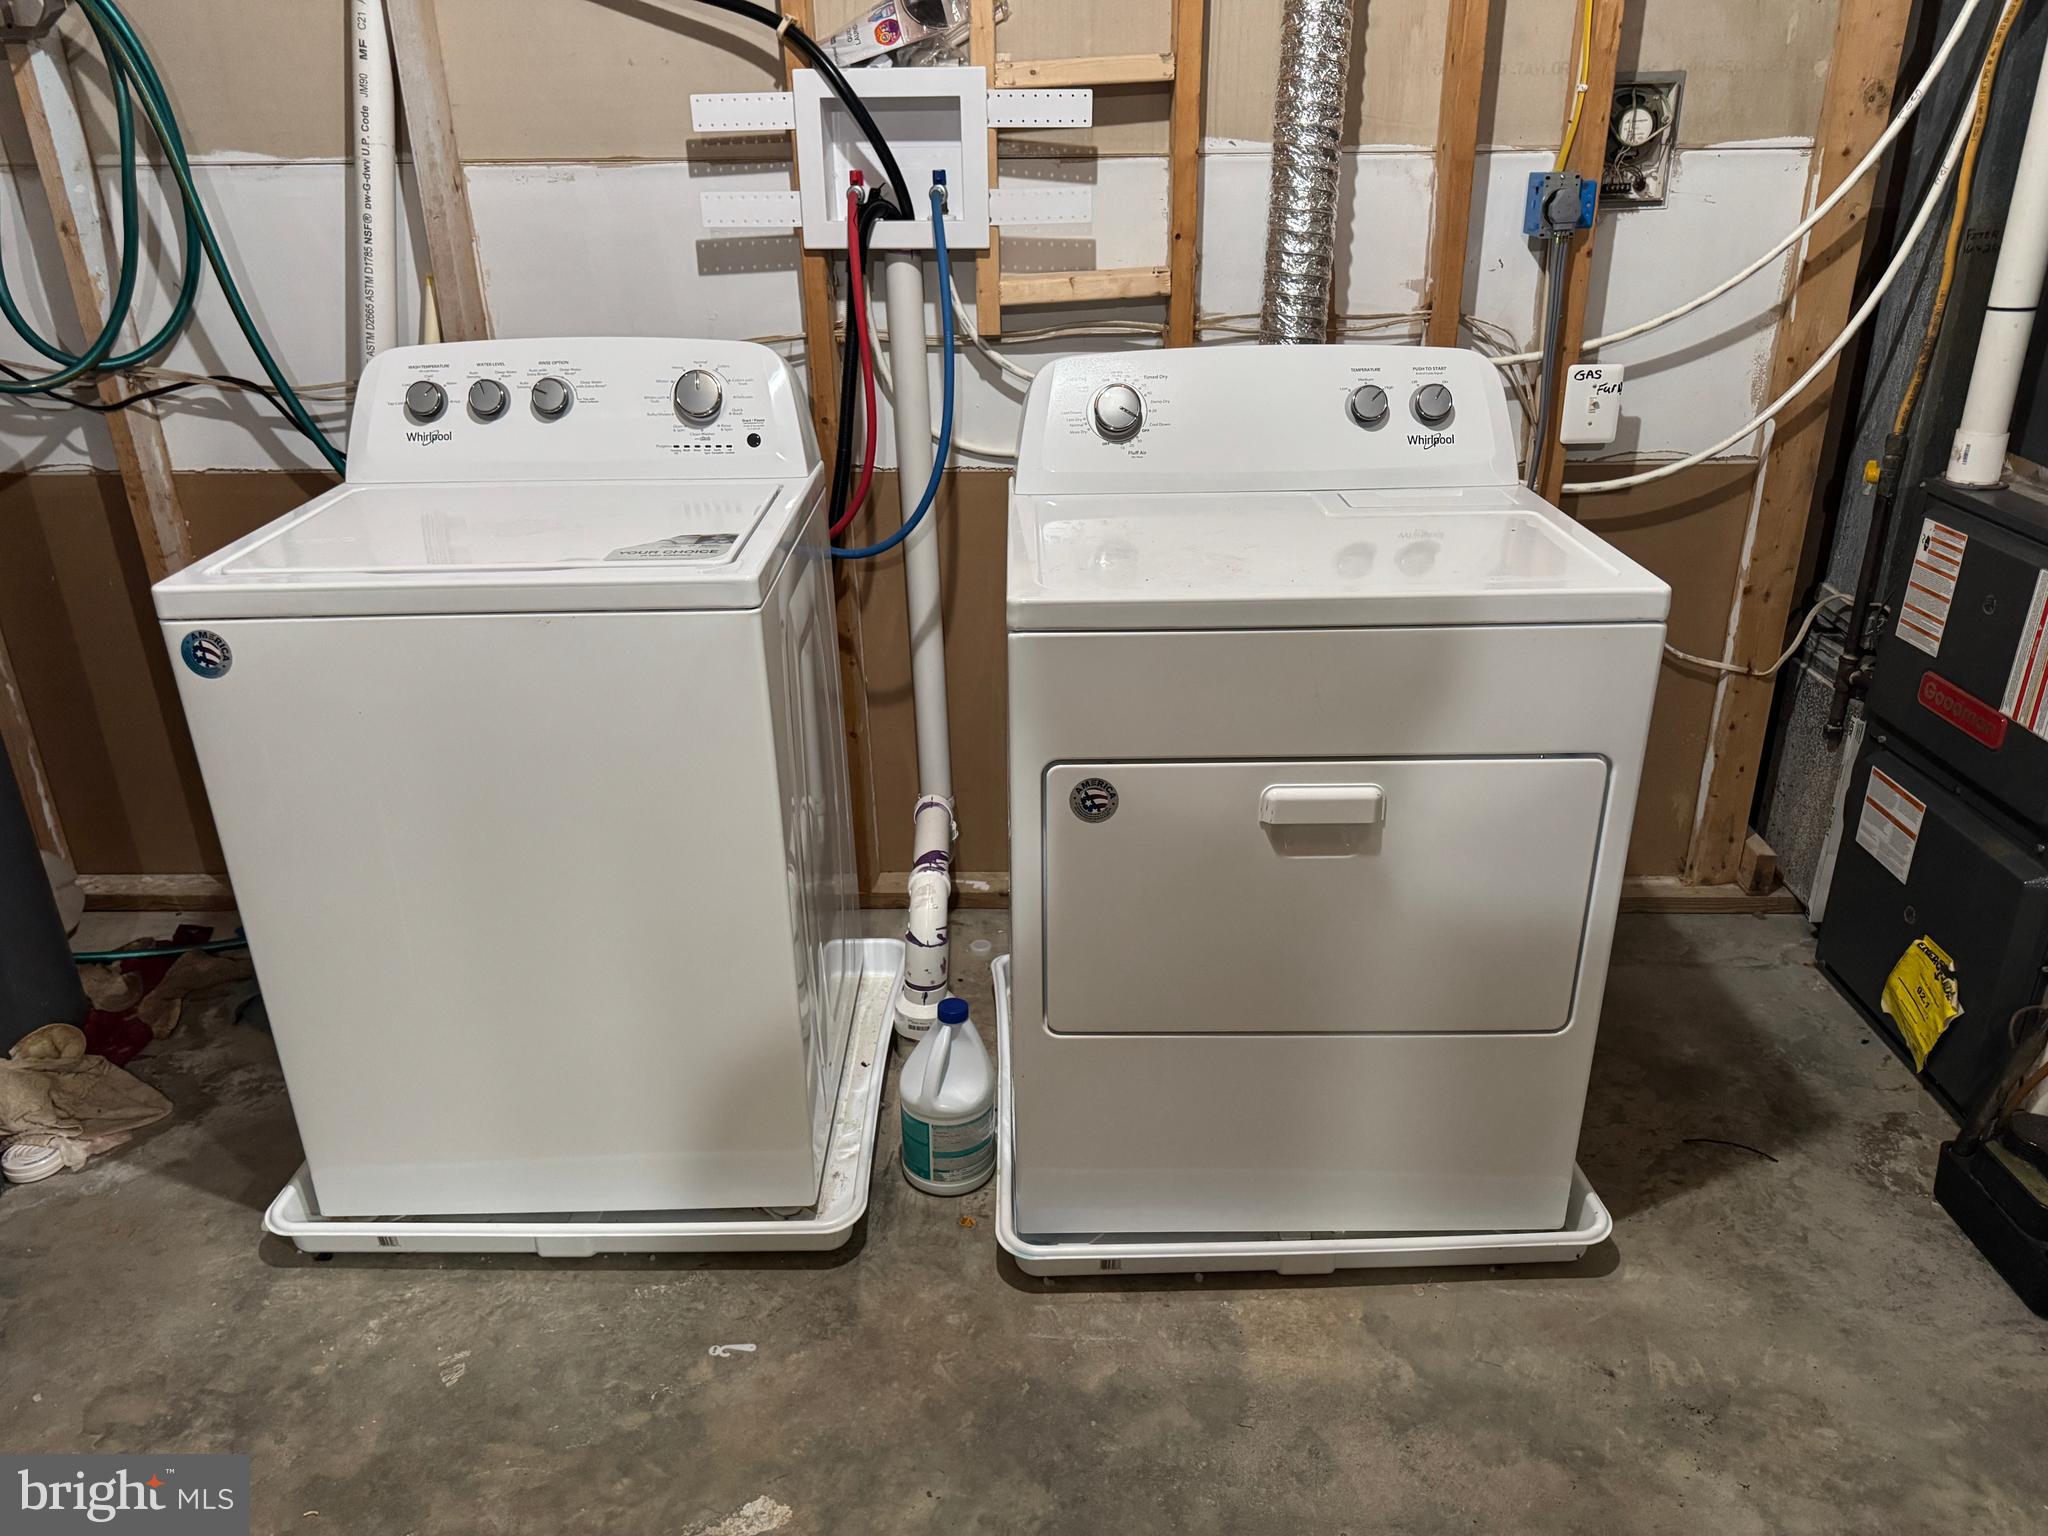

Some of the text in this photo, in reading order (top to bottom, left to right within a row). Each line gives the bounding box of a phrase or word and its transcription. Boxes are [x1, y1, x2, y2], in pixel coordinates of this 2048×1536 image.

[358, 12, 366, 30] C21
[358, 38, 368, 60] MF
[359, 73, 368, 98] JM90
[360, 105, 370, 132] Code
[364, 246, 374, 274] D1785
[364, 275, 374, 301] ASTM
[365, 304, 374, 335] D2665
[366, 336, 375, 357] ASTM
[1574, 370, 1602, 381] GAS
[406, 430, 452, 446] Whirlpool
[1407, 433, 1454, 449] Whirlpool
[191, 631, 230, 662] AMERICA
[1924, 682, 1997, 735] Goodman
[1076, 780, 1116, 800] AMERICA
